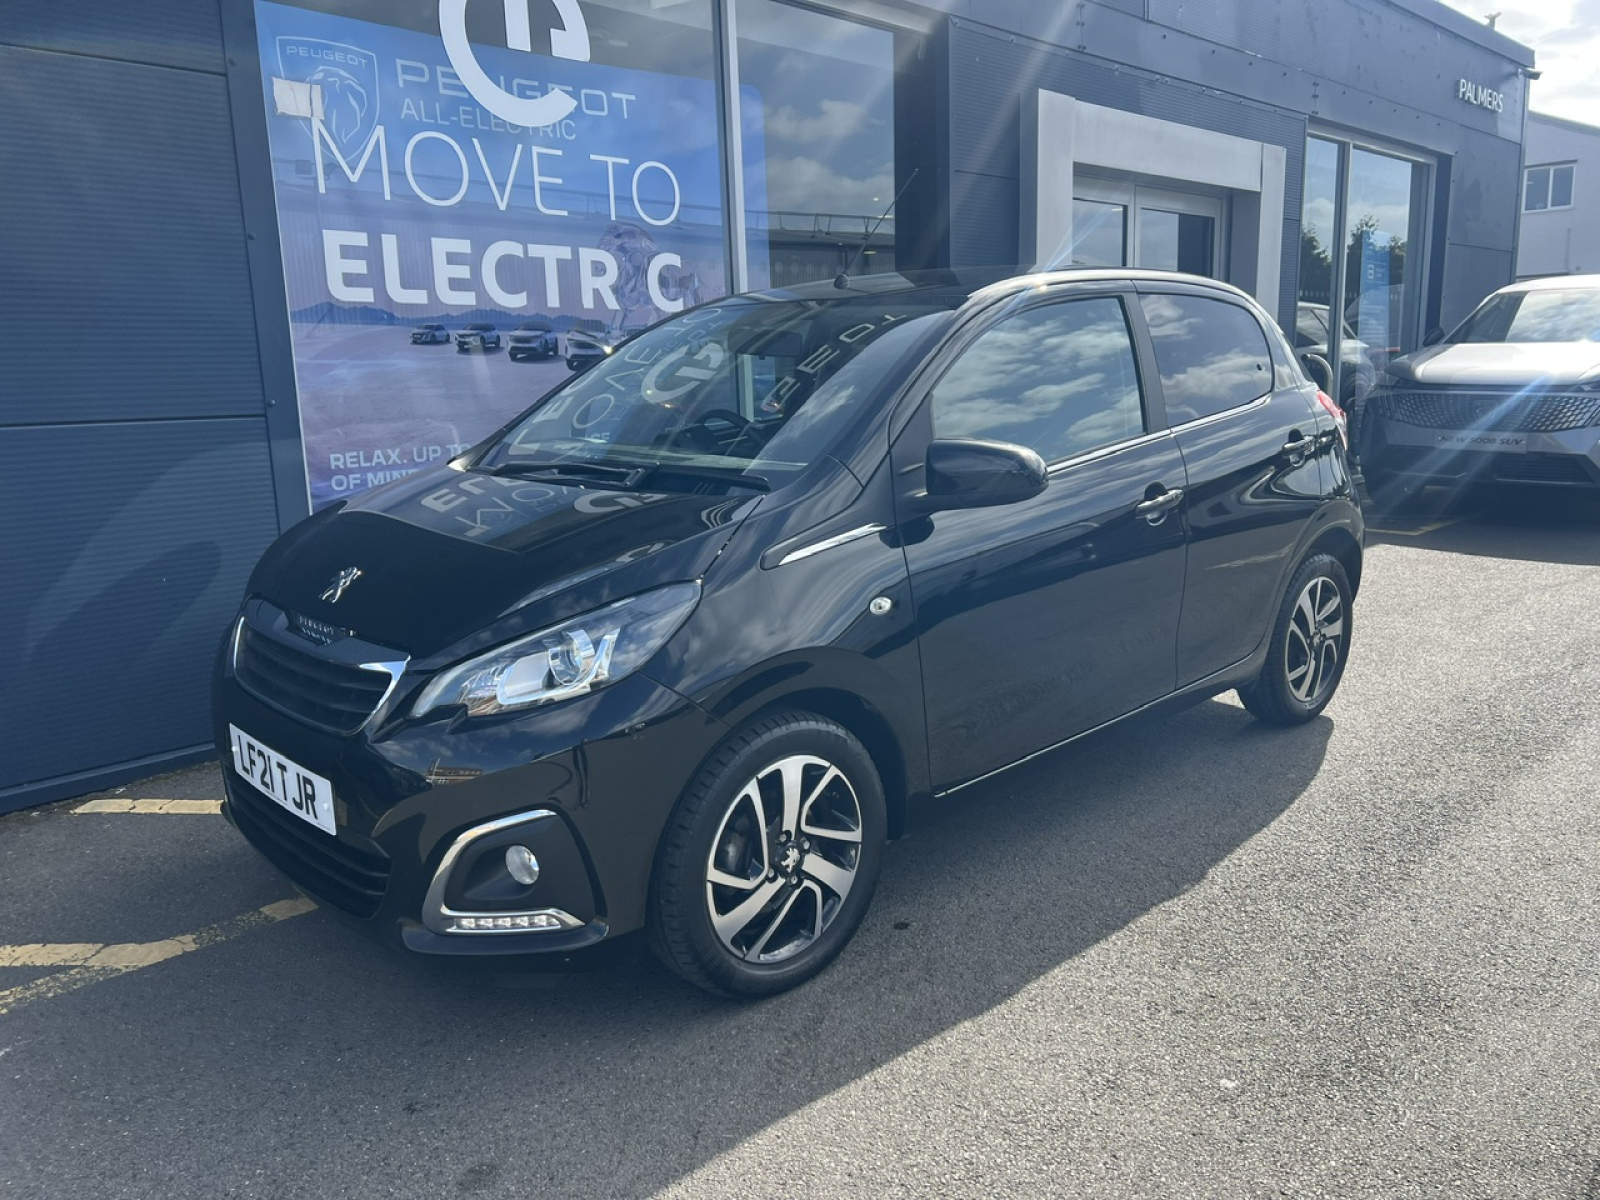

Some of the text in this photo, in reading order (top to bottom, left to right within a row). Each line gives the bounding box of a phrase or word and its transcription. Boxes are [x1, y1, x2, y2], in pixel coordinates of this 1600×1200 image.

[286, 45, 369, 69] PEUGEOT
[1459, 78, 1504, 113] PALMERS
[311, 118, 681, 226] MOVE TO
[322, 229, 684, 313] ELECTRC
[329, 448, 407, 470] RELAX.
[413, 445, 442, 463] UP
[330, 474, 361, 491] OF
